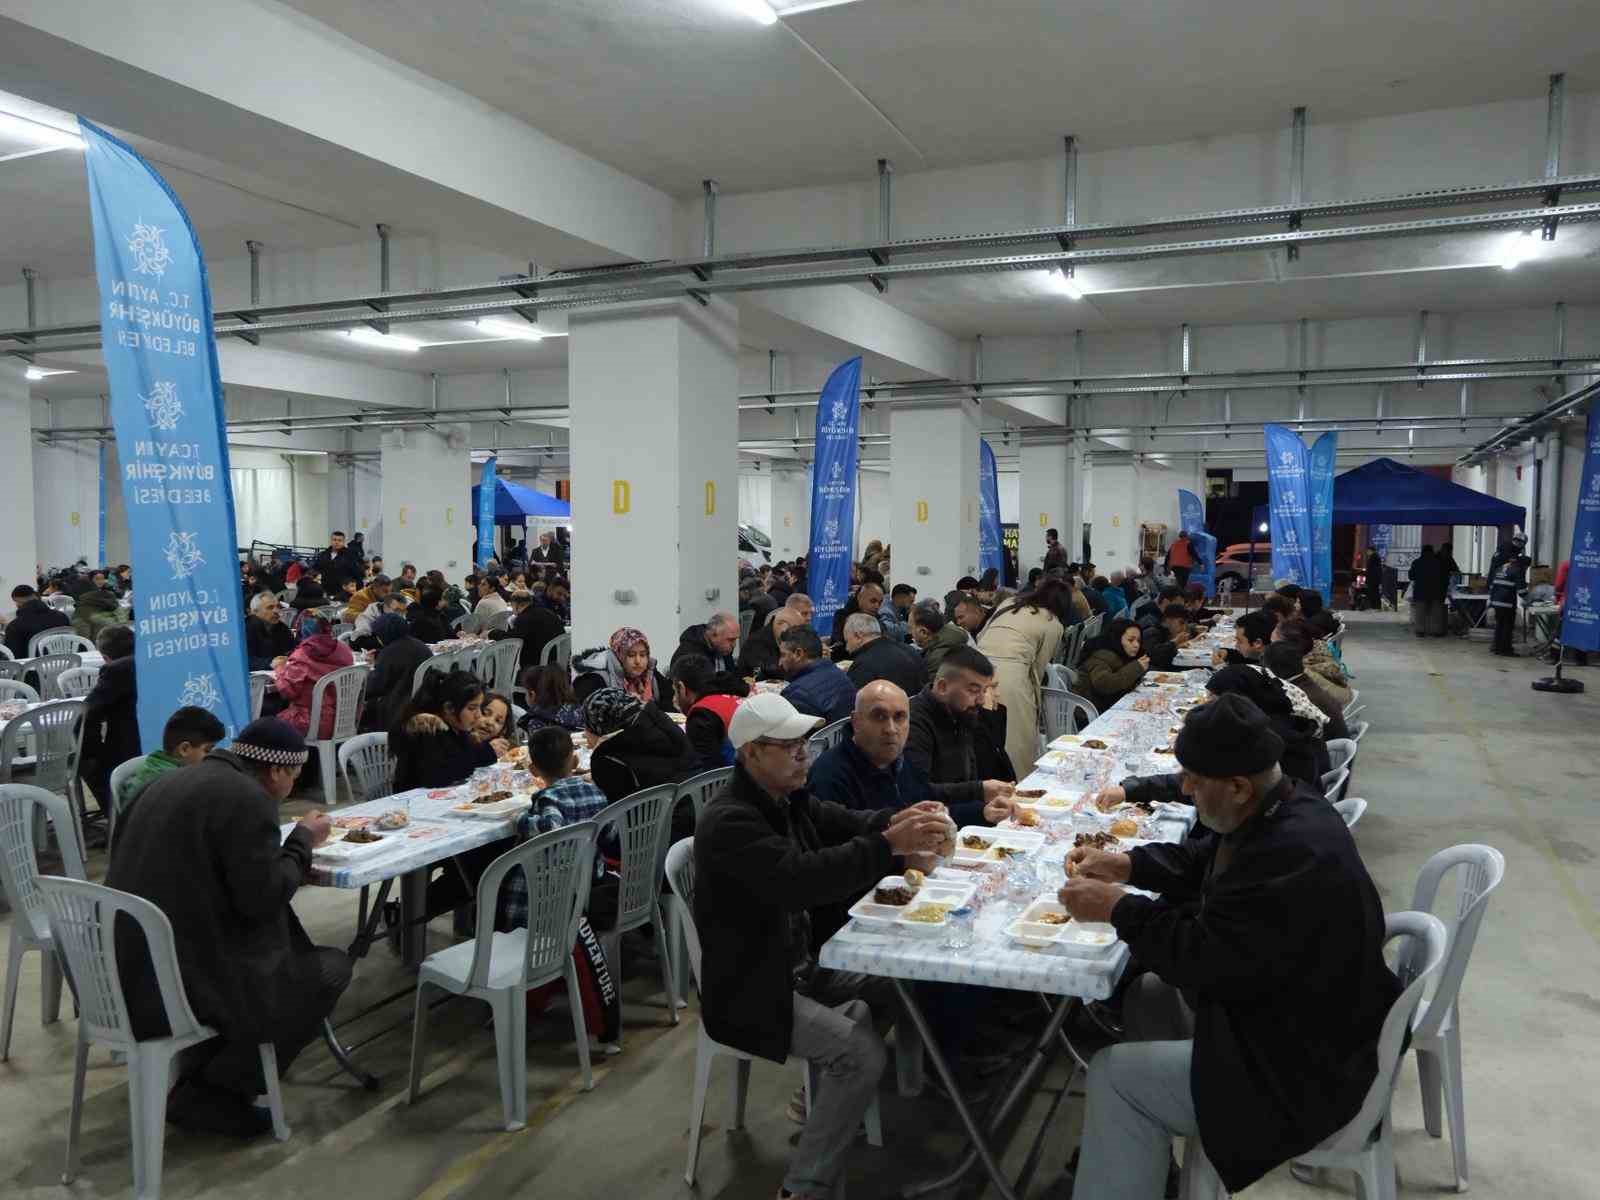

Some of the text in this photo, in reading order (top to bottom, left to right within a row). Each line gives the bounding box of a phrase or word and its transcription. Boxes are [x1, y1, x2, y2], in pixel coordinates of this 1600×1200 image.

[612, 480, 632, 515] D
[703, 480, 717, 516] D
[577, 916, 617, 1006] ADVENTURE
